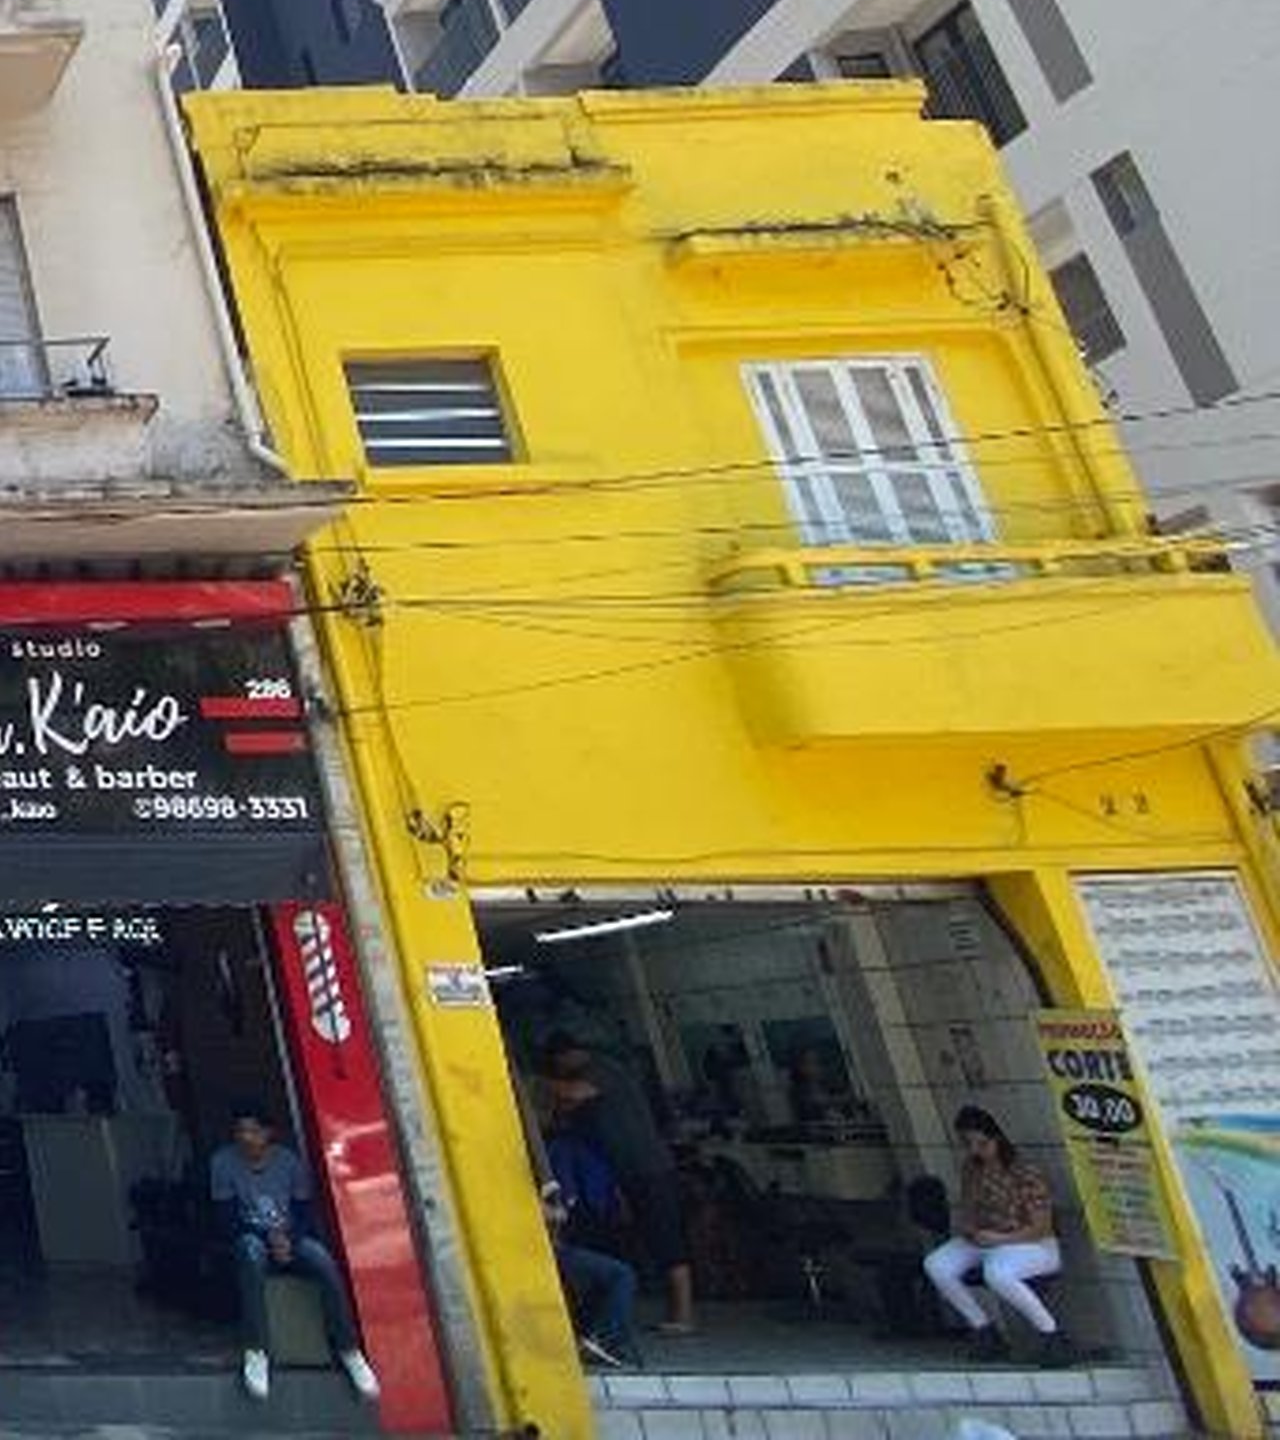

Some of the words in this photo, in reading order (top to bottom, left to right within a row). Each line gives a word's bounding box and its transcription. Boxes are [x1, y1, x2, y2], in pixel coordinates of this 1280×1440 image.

[11, 639, 101, 658] studio
[65, 765, 87, 790] &
[95, 764, 197, 790] barber
